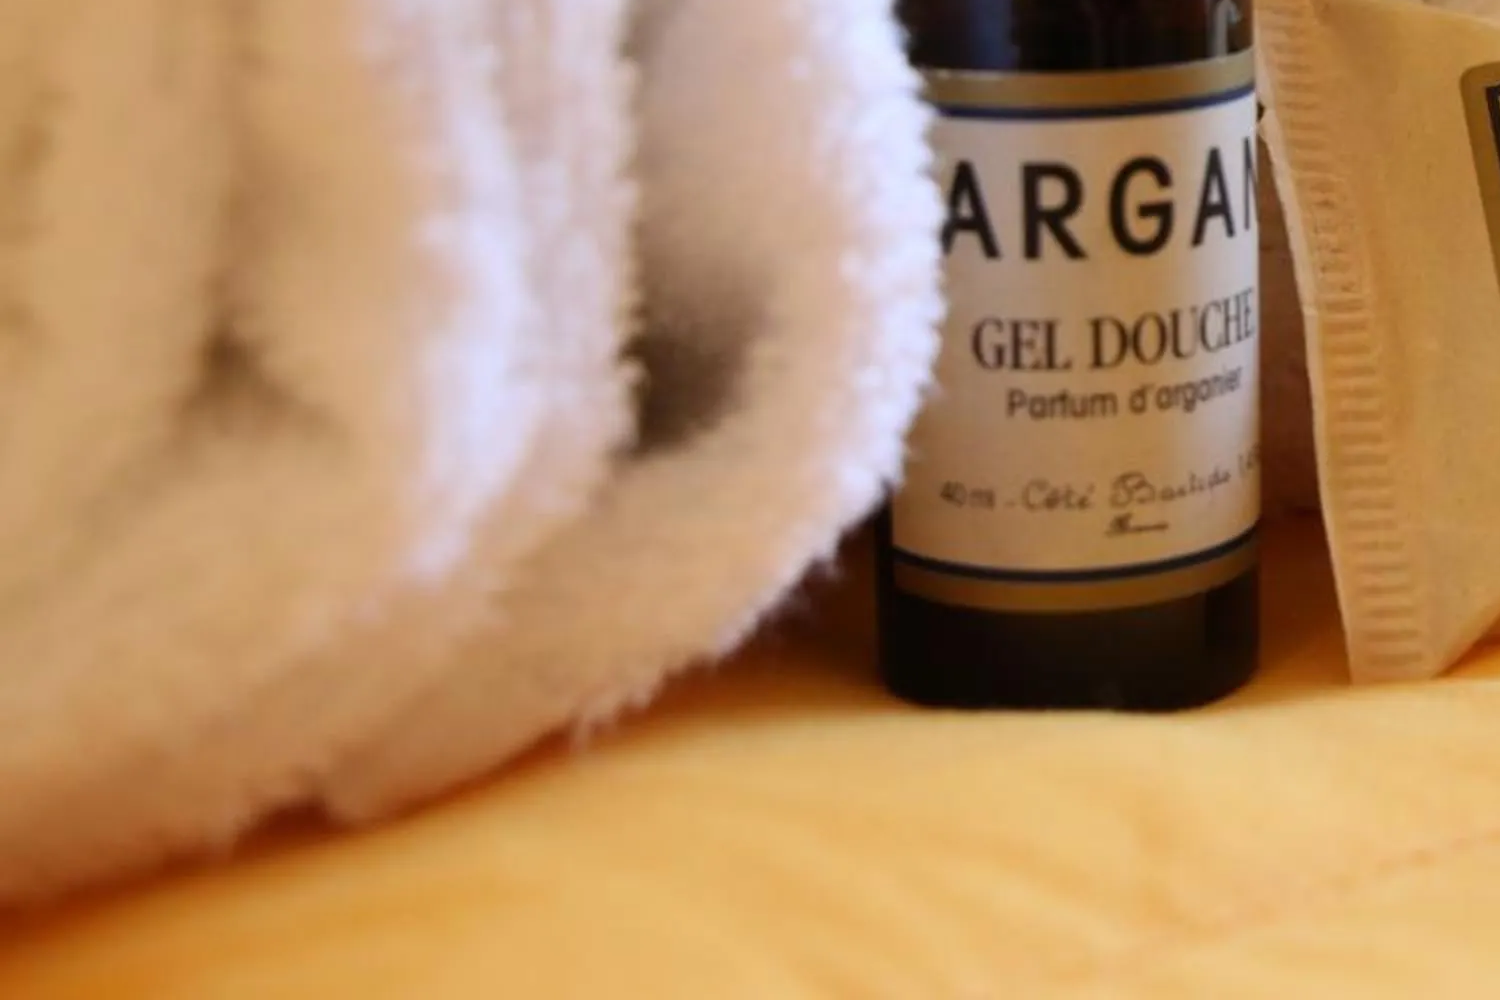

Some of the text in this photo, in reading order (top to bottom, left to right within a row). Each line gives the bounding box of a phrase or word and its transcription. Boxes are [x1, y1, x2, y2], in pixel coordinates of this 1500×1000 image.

[972, 288, 1254, 371] GEL DOUCHE
[1007, 388, 1118, 420] Parfum
